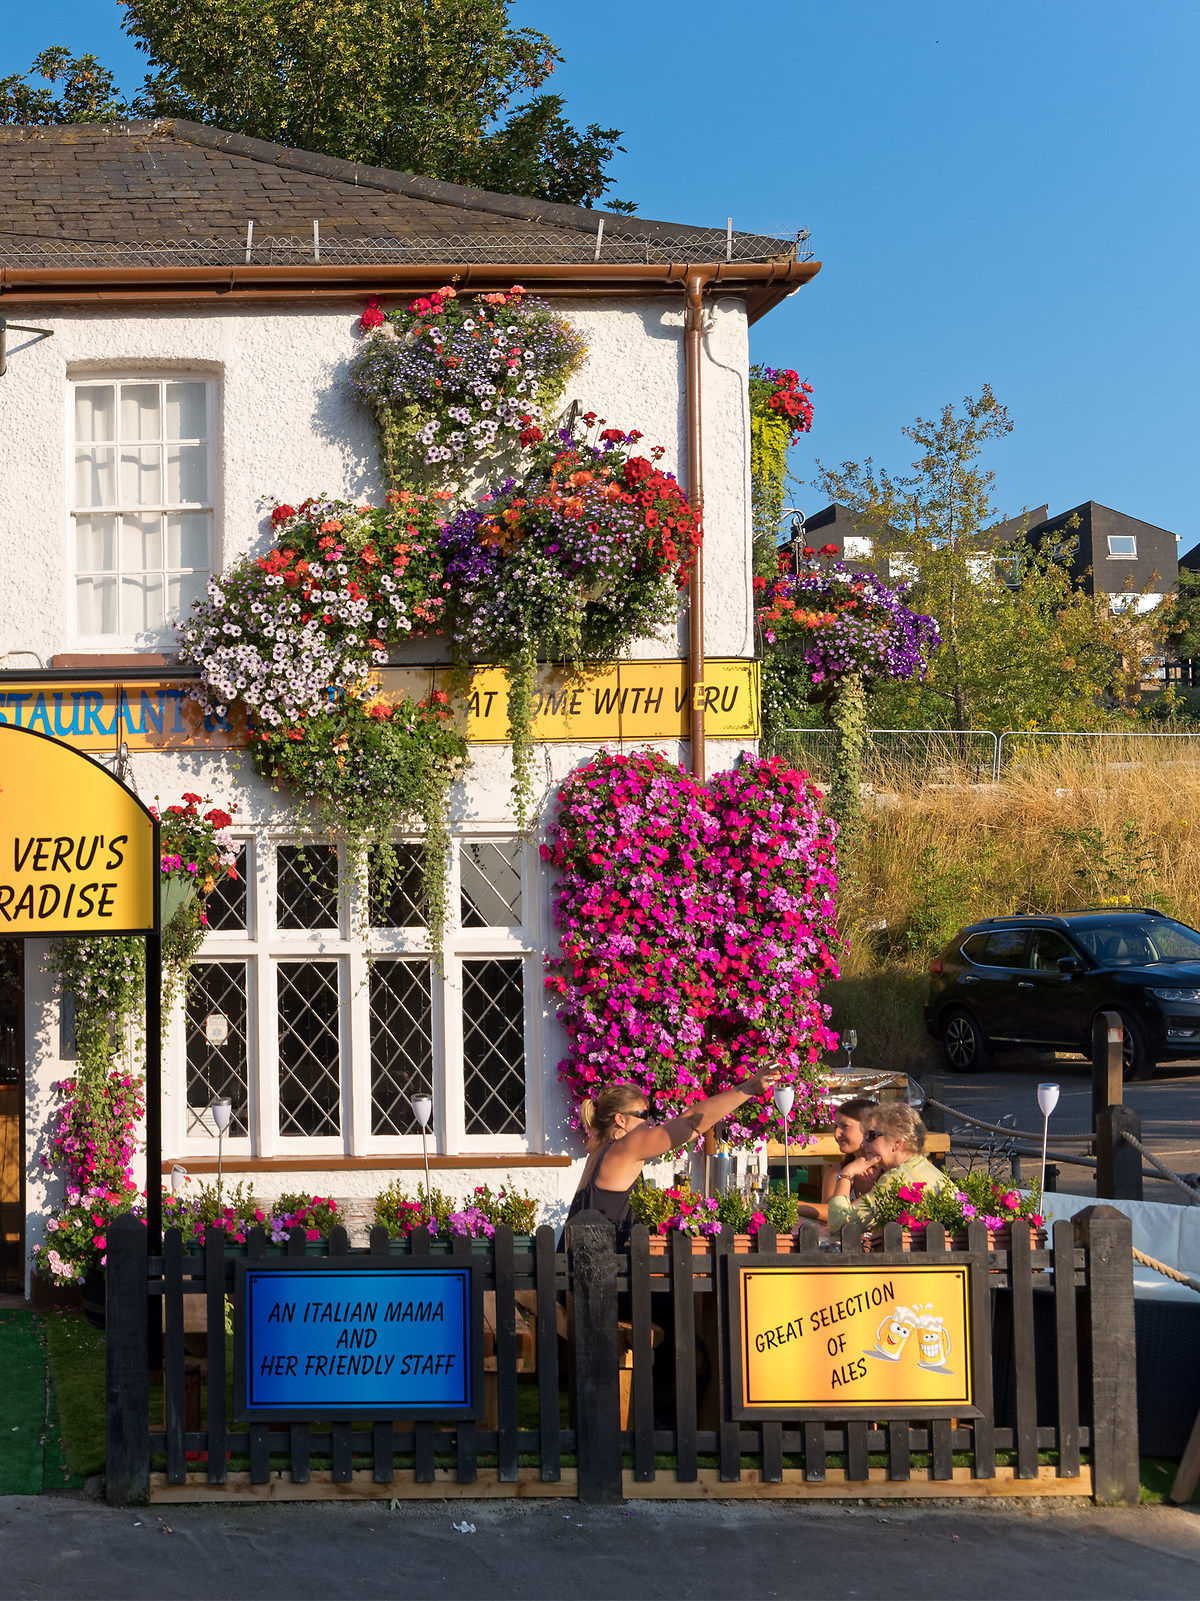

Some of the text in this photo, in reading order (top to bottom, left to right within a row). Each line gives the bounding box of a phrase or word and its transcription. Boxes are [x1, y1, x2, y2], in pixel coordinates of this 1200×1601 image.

[463, 685, 739, 718] AT OME WITH VERU
[13, 834, 128, 873] VERU'S
[267, 1301, 445, 1323] AN ITALIAN MAMA
[754, 1281, 896, 1353] GREAT SELECTION
[336, 1328, 378, 1349] AND
[827, 1333, 848, 1357] OF
[260, 1354, 456, 1377] HER FRIENDLY STAFF
[830, 1357, 868, 1390] ALES
